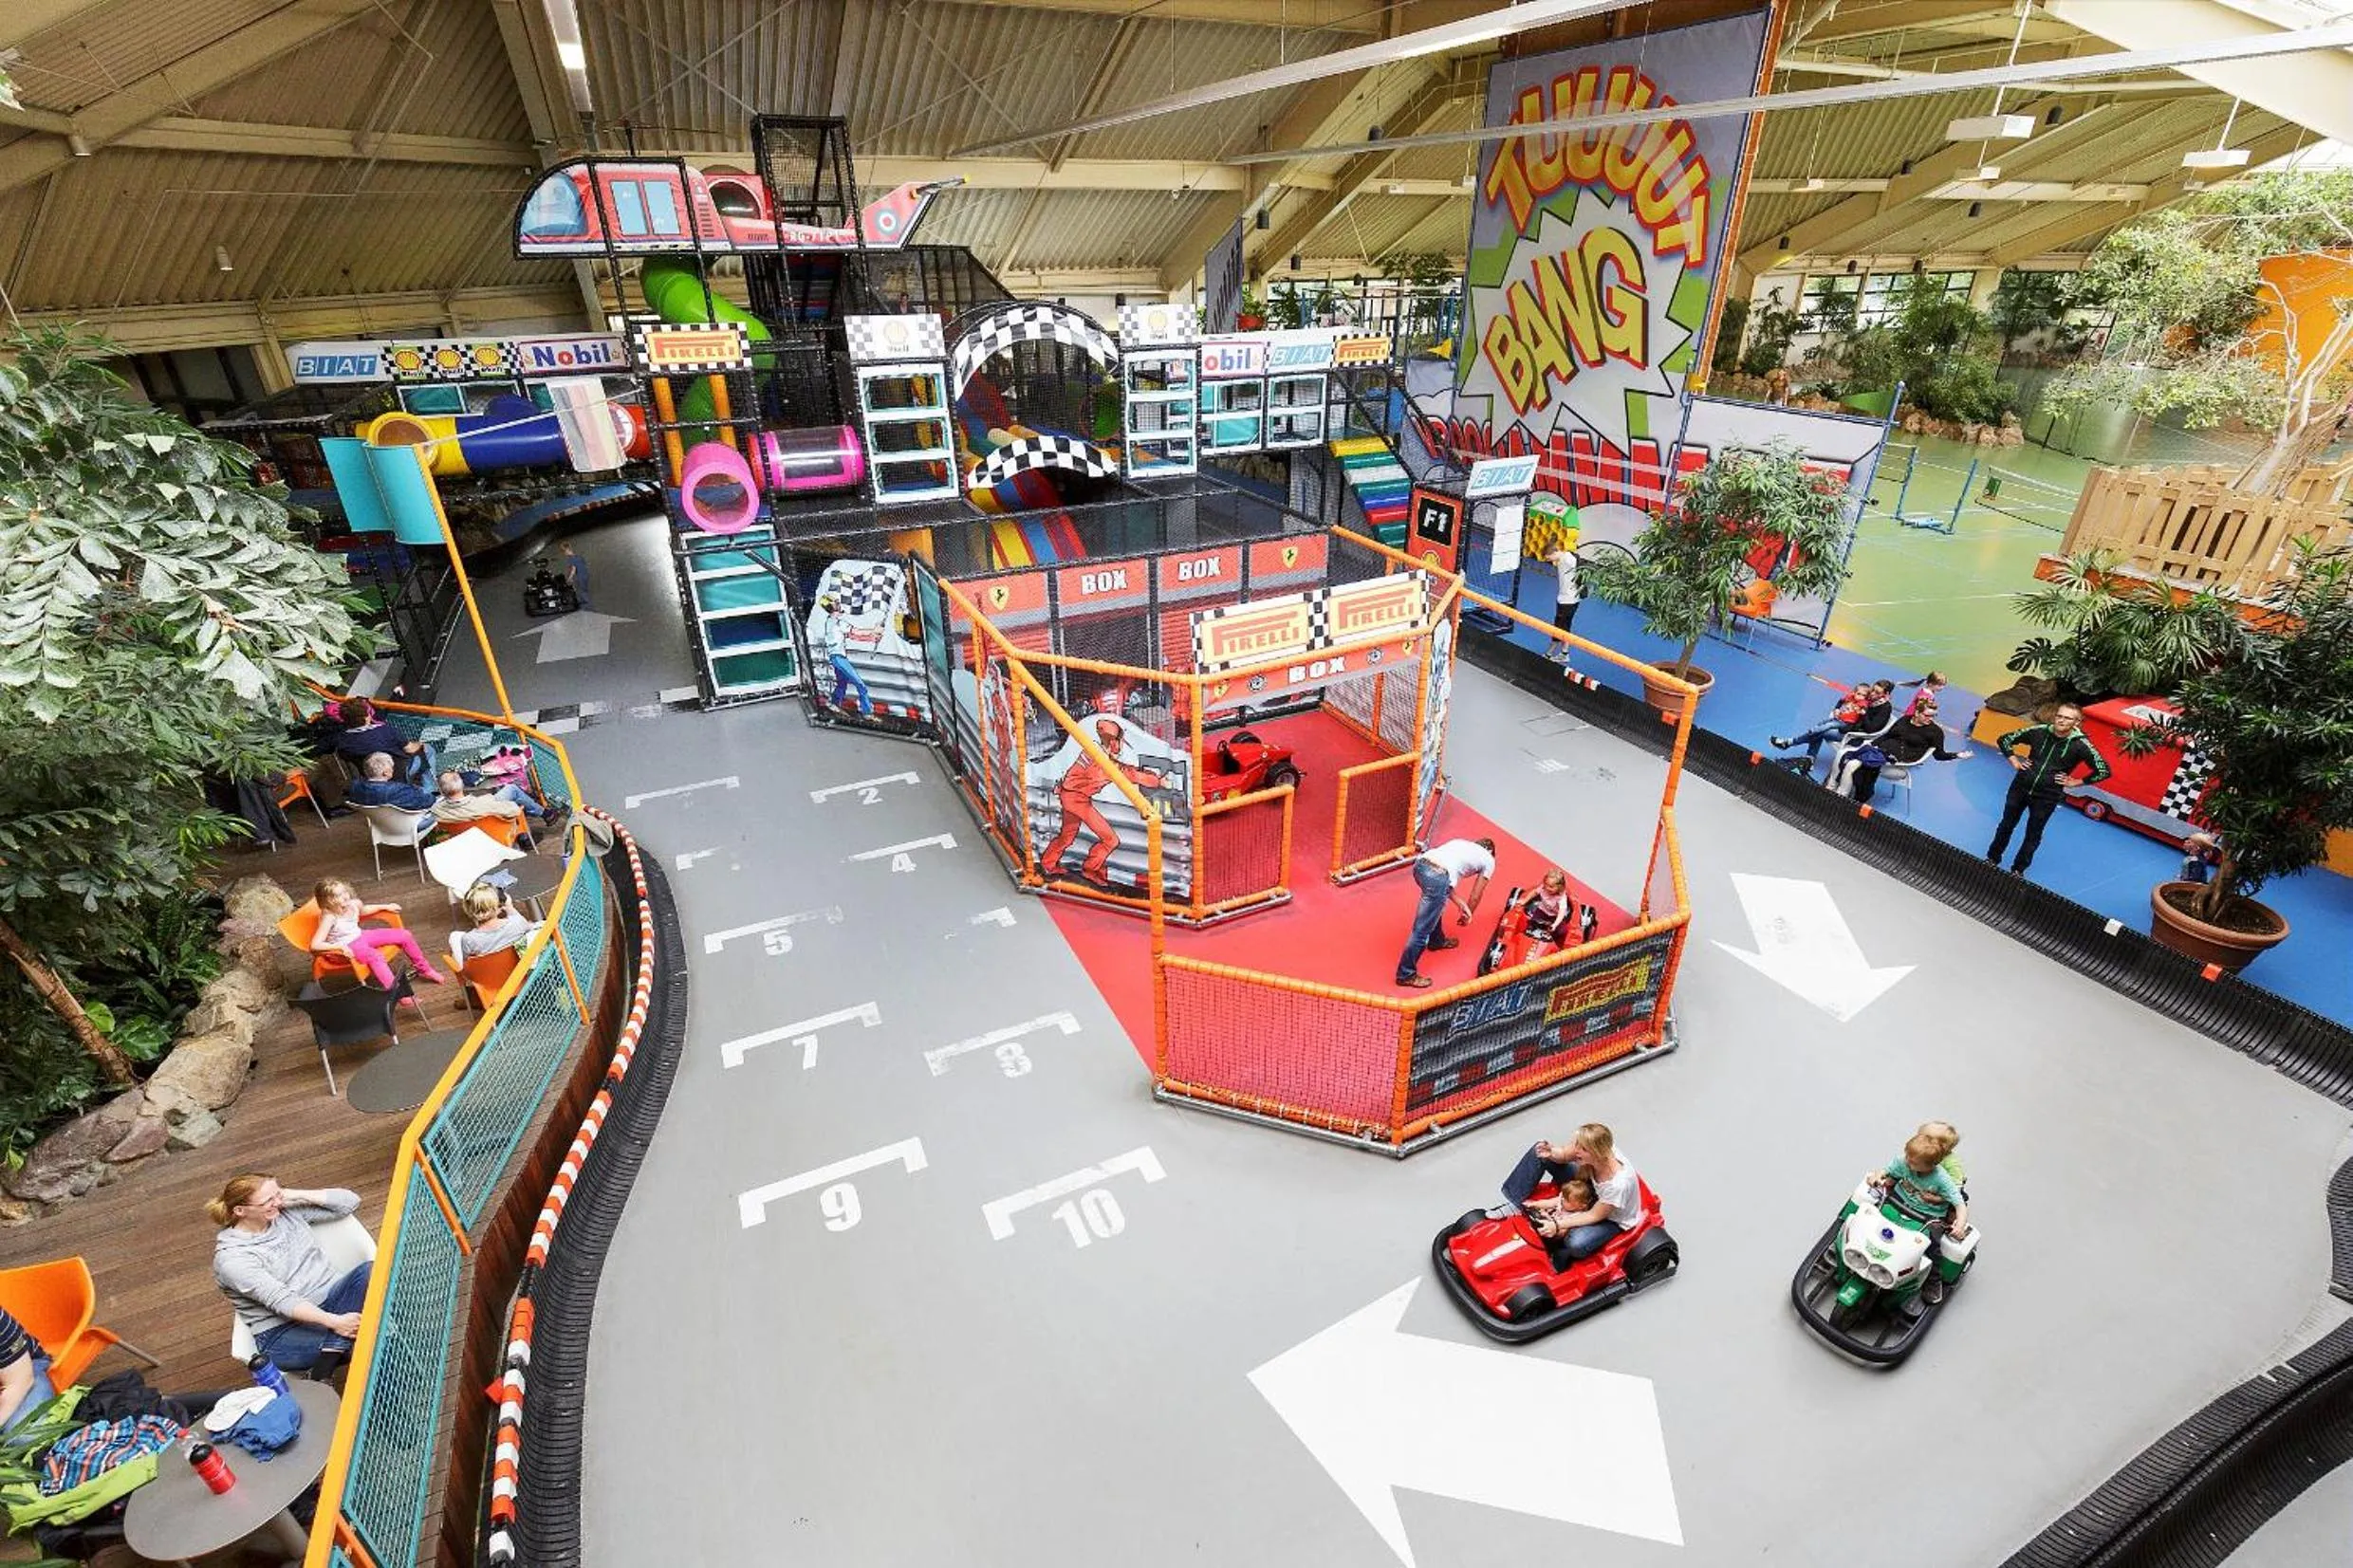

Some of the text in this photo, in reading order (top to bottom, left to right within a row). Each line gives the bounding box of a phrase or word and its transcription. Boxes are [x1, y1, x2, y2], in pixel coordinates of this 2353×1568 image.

[1487, 66, 1709, 268] TUUUUT
[1483, 226, 1649, 415] BANG
[531, 342, 611, 367] Nobil
[653, 334, 735, 359] PIRELLI
[1204, 347, 1251, 371] obil
[1270, 344, 1330, 366] BIAT
[297, 356, 377, 377] BIAT
[1472, 463, 1534, 489] BIAT
[1424, 507, 1448, 535] F1
[1081, 569, 1127, 595] BOX
[1178, 556, 1221, 581] BOX
[1339, 588, 1414, 629] PIRELLI
[1212, 611, 1300, 656] PIRELLI
[1288, 656, 1346, 684] BOX
[858, 787, 883, 805] 2
[891, 853, 917, 874] 4
[763, 930, 793, 956] 5
[1452, 985, 1533, 1027] BIAT
[791, 1034, 818, 1070] 7
[994, 1042, 1032, 1079] 8
[820, 1183, 862, 1232] 9
[1052, 1189, 1126, 1248] 10
